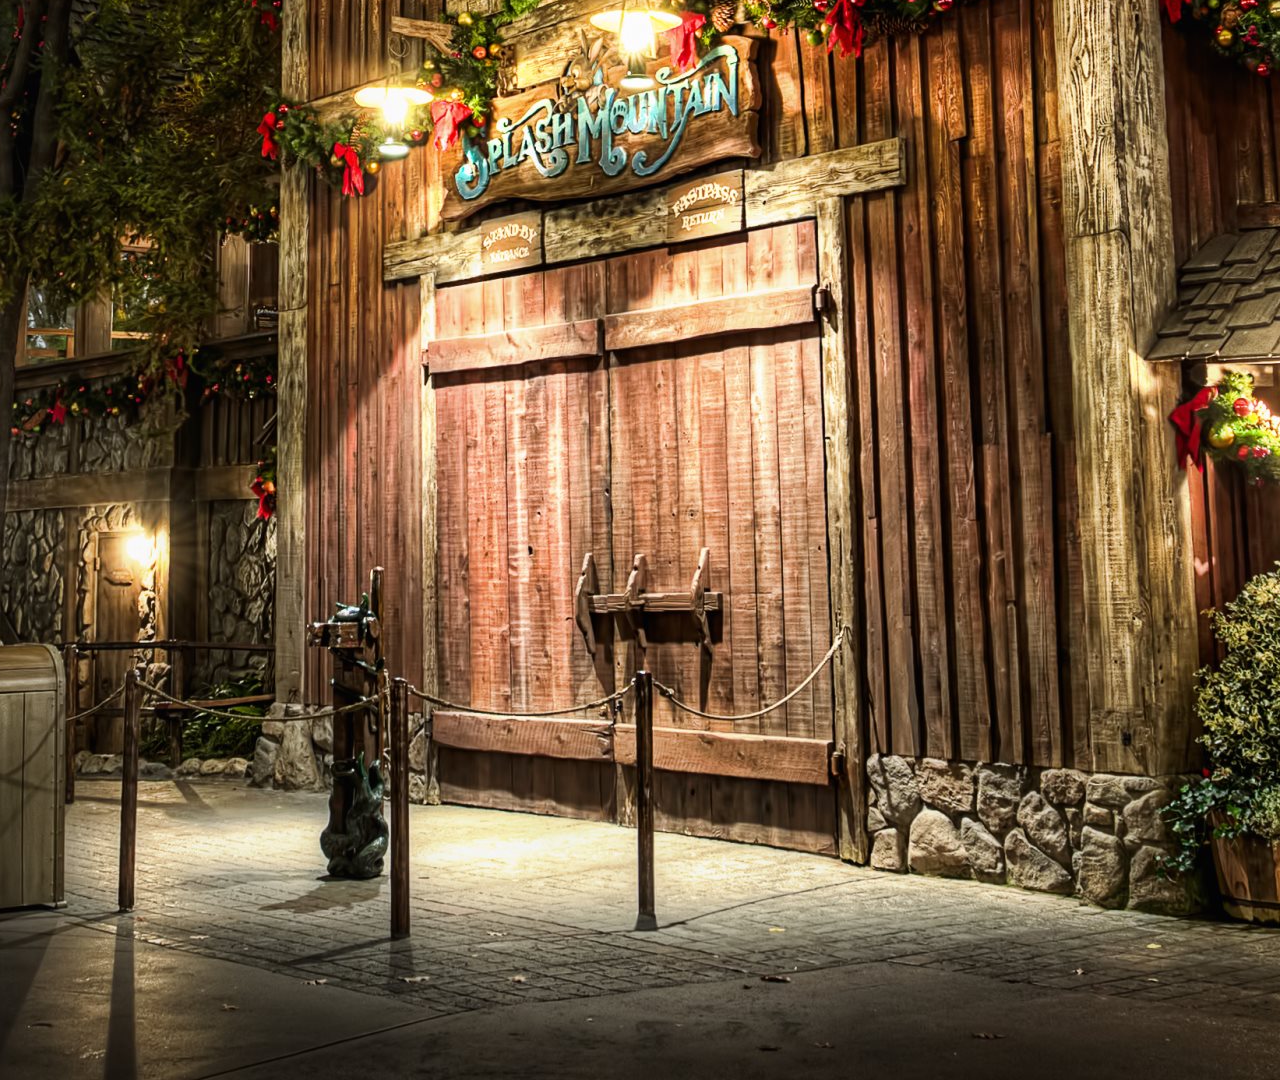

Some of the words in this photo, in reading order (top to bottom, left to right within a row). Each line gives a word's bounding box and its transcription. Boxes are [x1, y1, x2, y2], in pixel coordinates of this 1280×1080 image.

[455, 98, 575, 200] SPLASH
[576, 45, 739, 177] MOUNTAIN
[672, 182, 738, 218] FASTPASS
[682, 208, 726, 231] RETURN
[483, 223, 537, 250] STAND-BY
